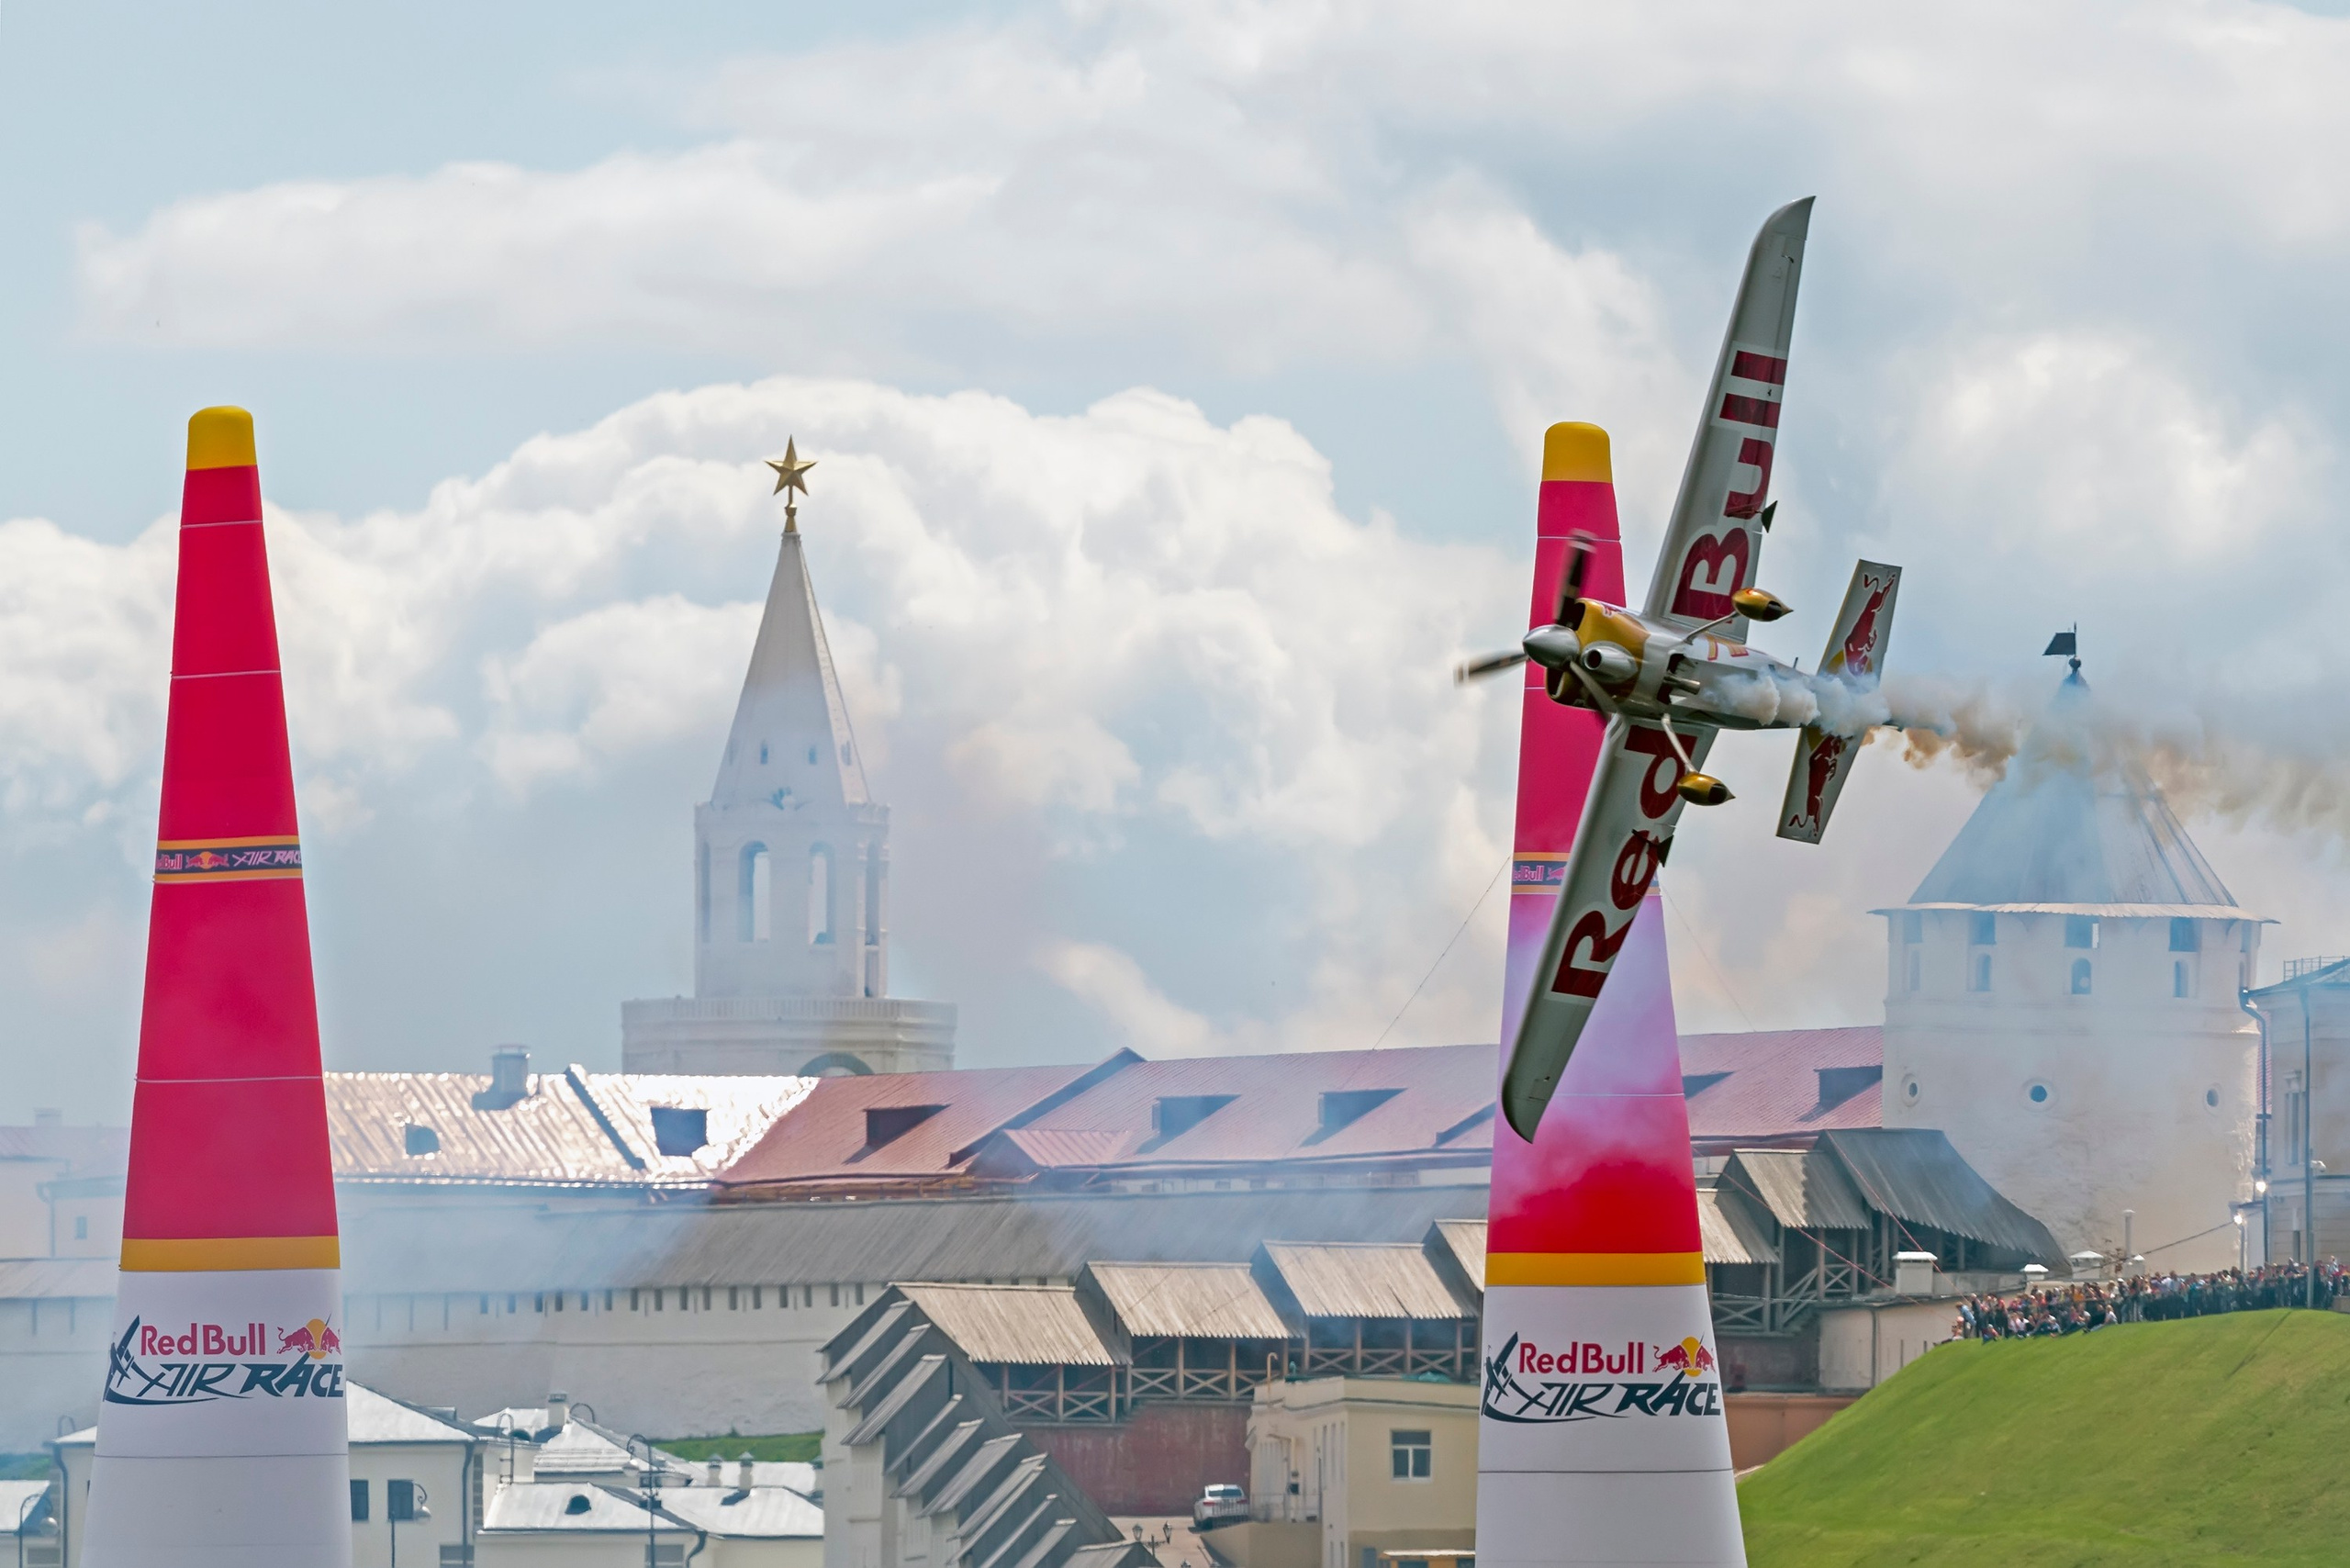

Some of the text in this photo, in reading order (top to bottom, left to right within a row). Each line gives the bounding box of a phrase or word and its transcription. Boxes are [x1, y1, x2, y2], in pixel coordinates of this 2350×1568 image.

[1550, 350, 1788, 999] Red Bull
[1520, 865, 1544, 881] Bull
[140, 1322, 266, 1356] Red Bull
[1519, 1341, 1644, 1374] Red Bull
[131, 1353, 344, 1399] AIR RACE
[1509, 1371, 1721, 1418] AIR RACE
